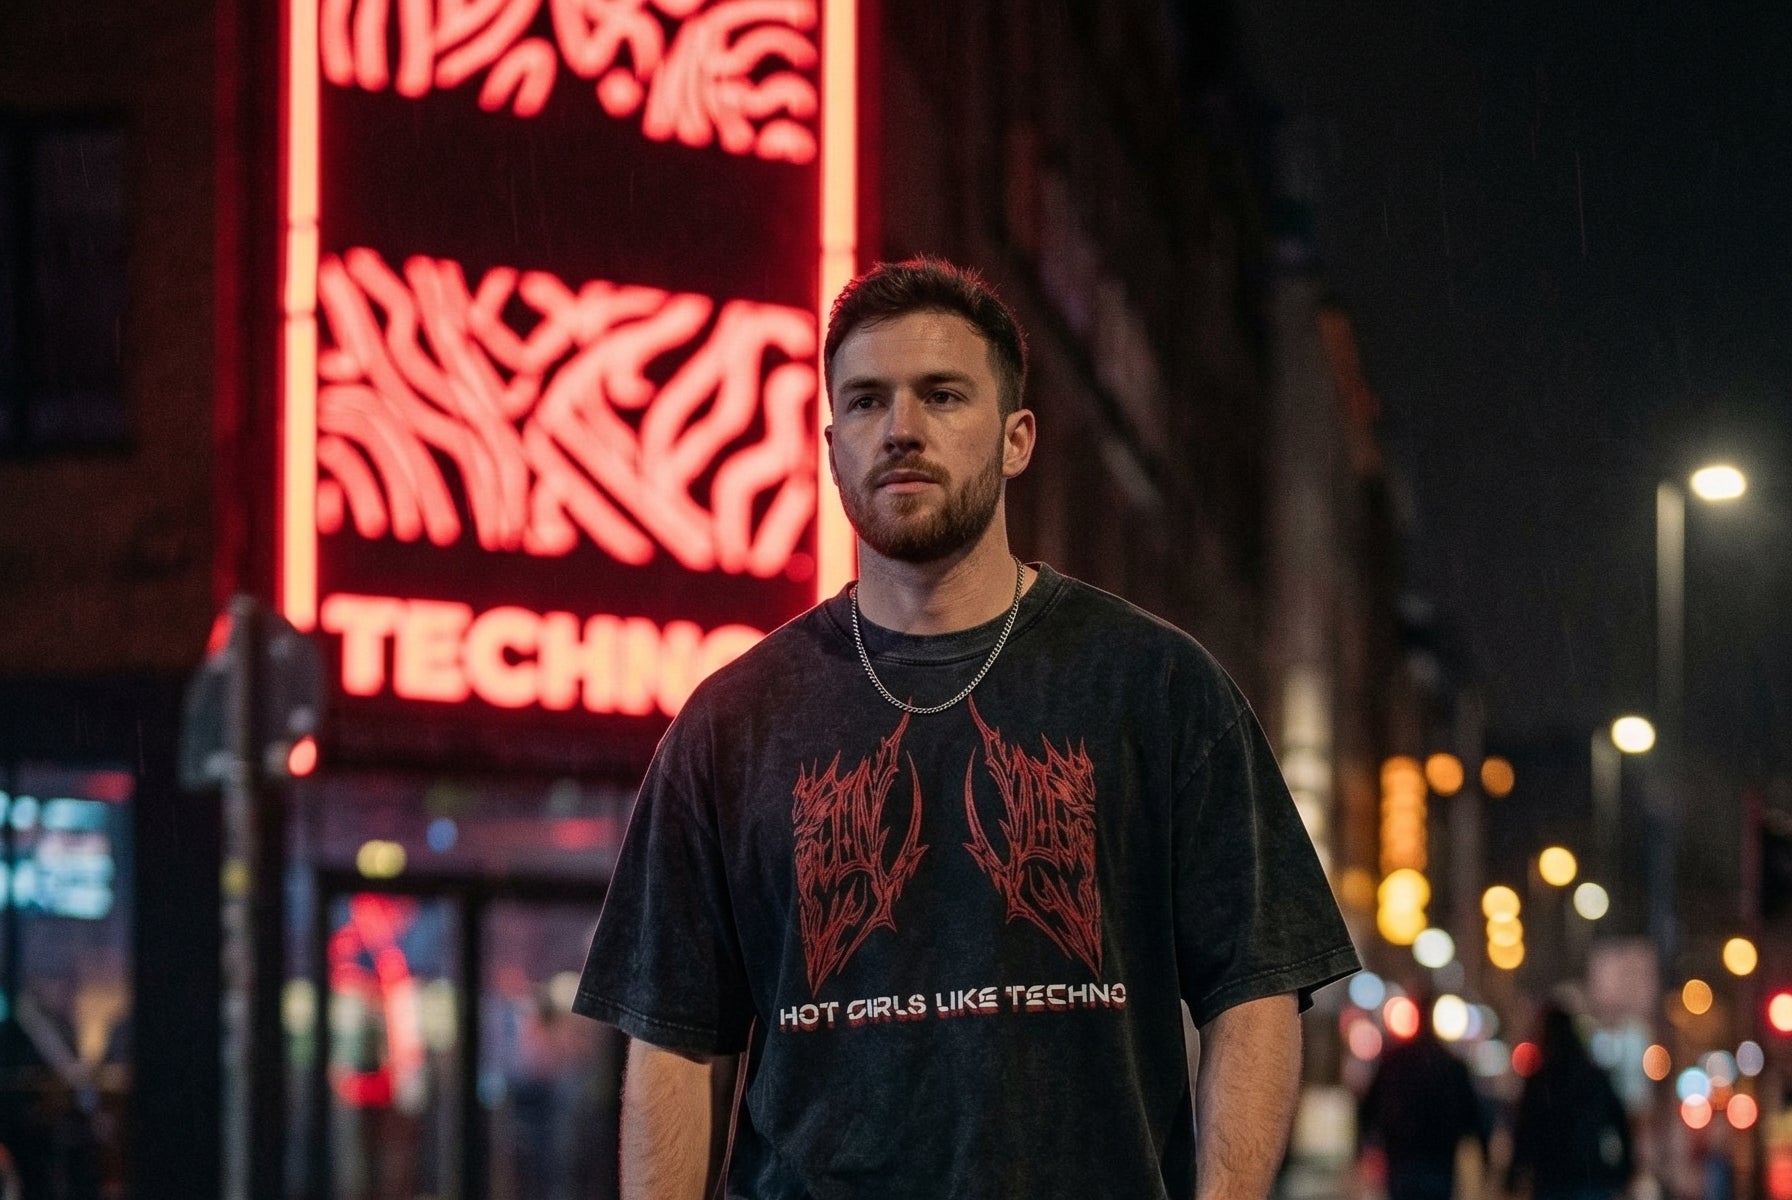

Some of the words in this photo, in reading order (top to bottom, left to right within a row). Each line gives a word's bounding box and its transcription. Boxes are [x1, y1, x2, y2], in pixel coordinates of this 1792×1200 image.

[779, 1001, 840, 1027] HOT
[846, 993, 928, 1022] GIRLS
[935, 986, 999, 1013] LIKE
[1004, 981, 1128, 1008] TECHNO
